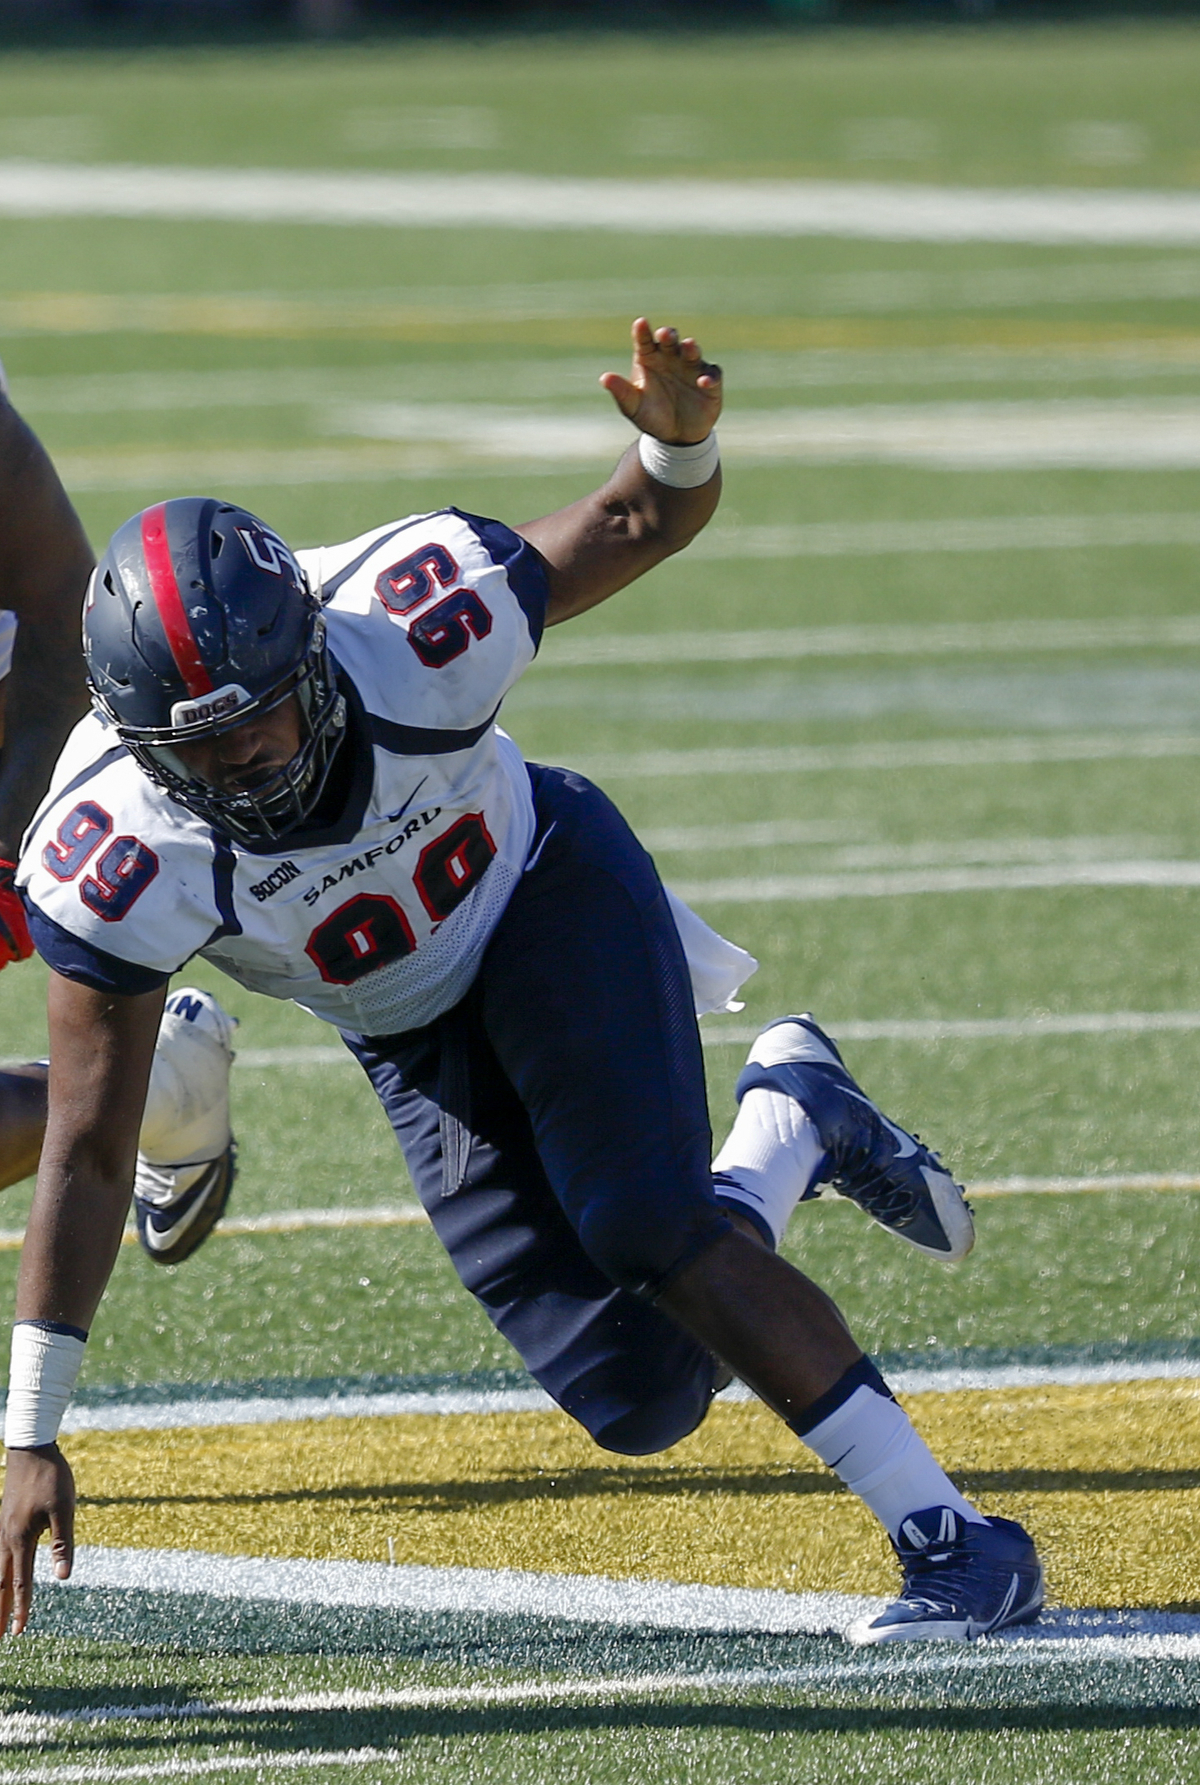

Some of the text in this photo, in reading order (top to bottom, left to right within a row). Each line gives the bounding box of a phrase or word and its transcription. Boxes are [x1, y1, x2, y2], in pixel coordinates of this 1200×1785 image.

[181, 690, 239, 725] DOGS
[41, 800, 160, 923] 99
[249, 860, 304, 903] SOCON
[303, 805, 442, 907] SAMFORD
